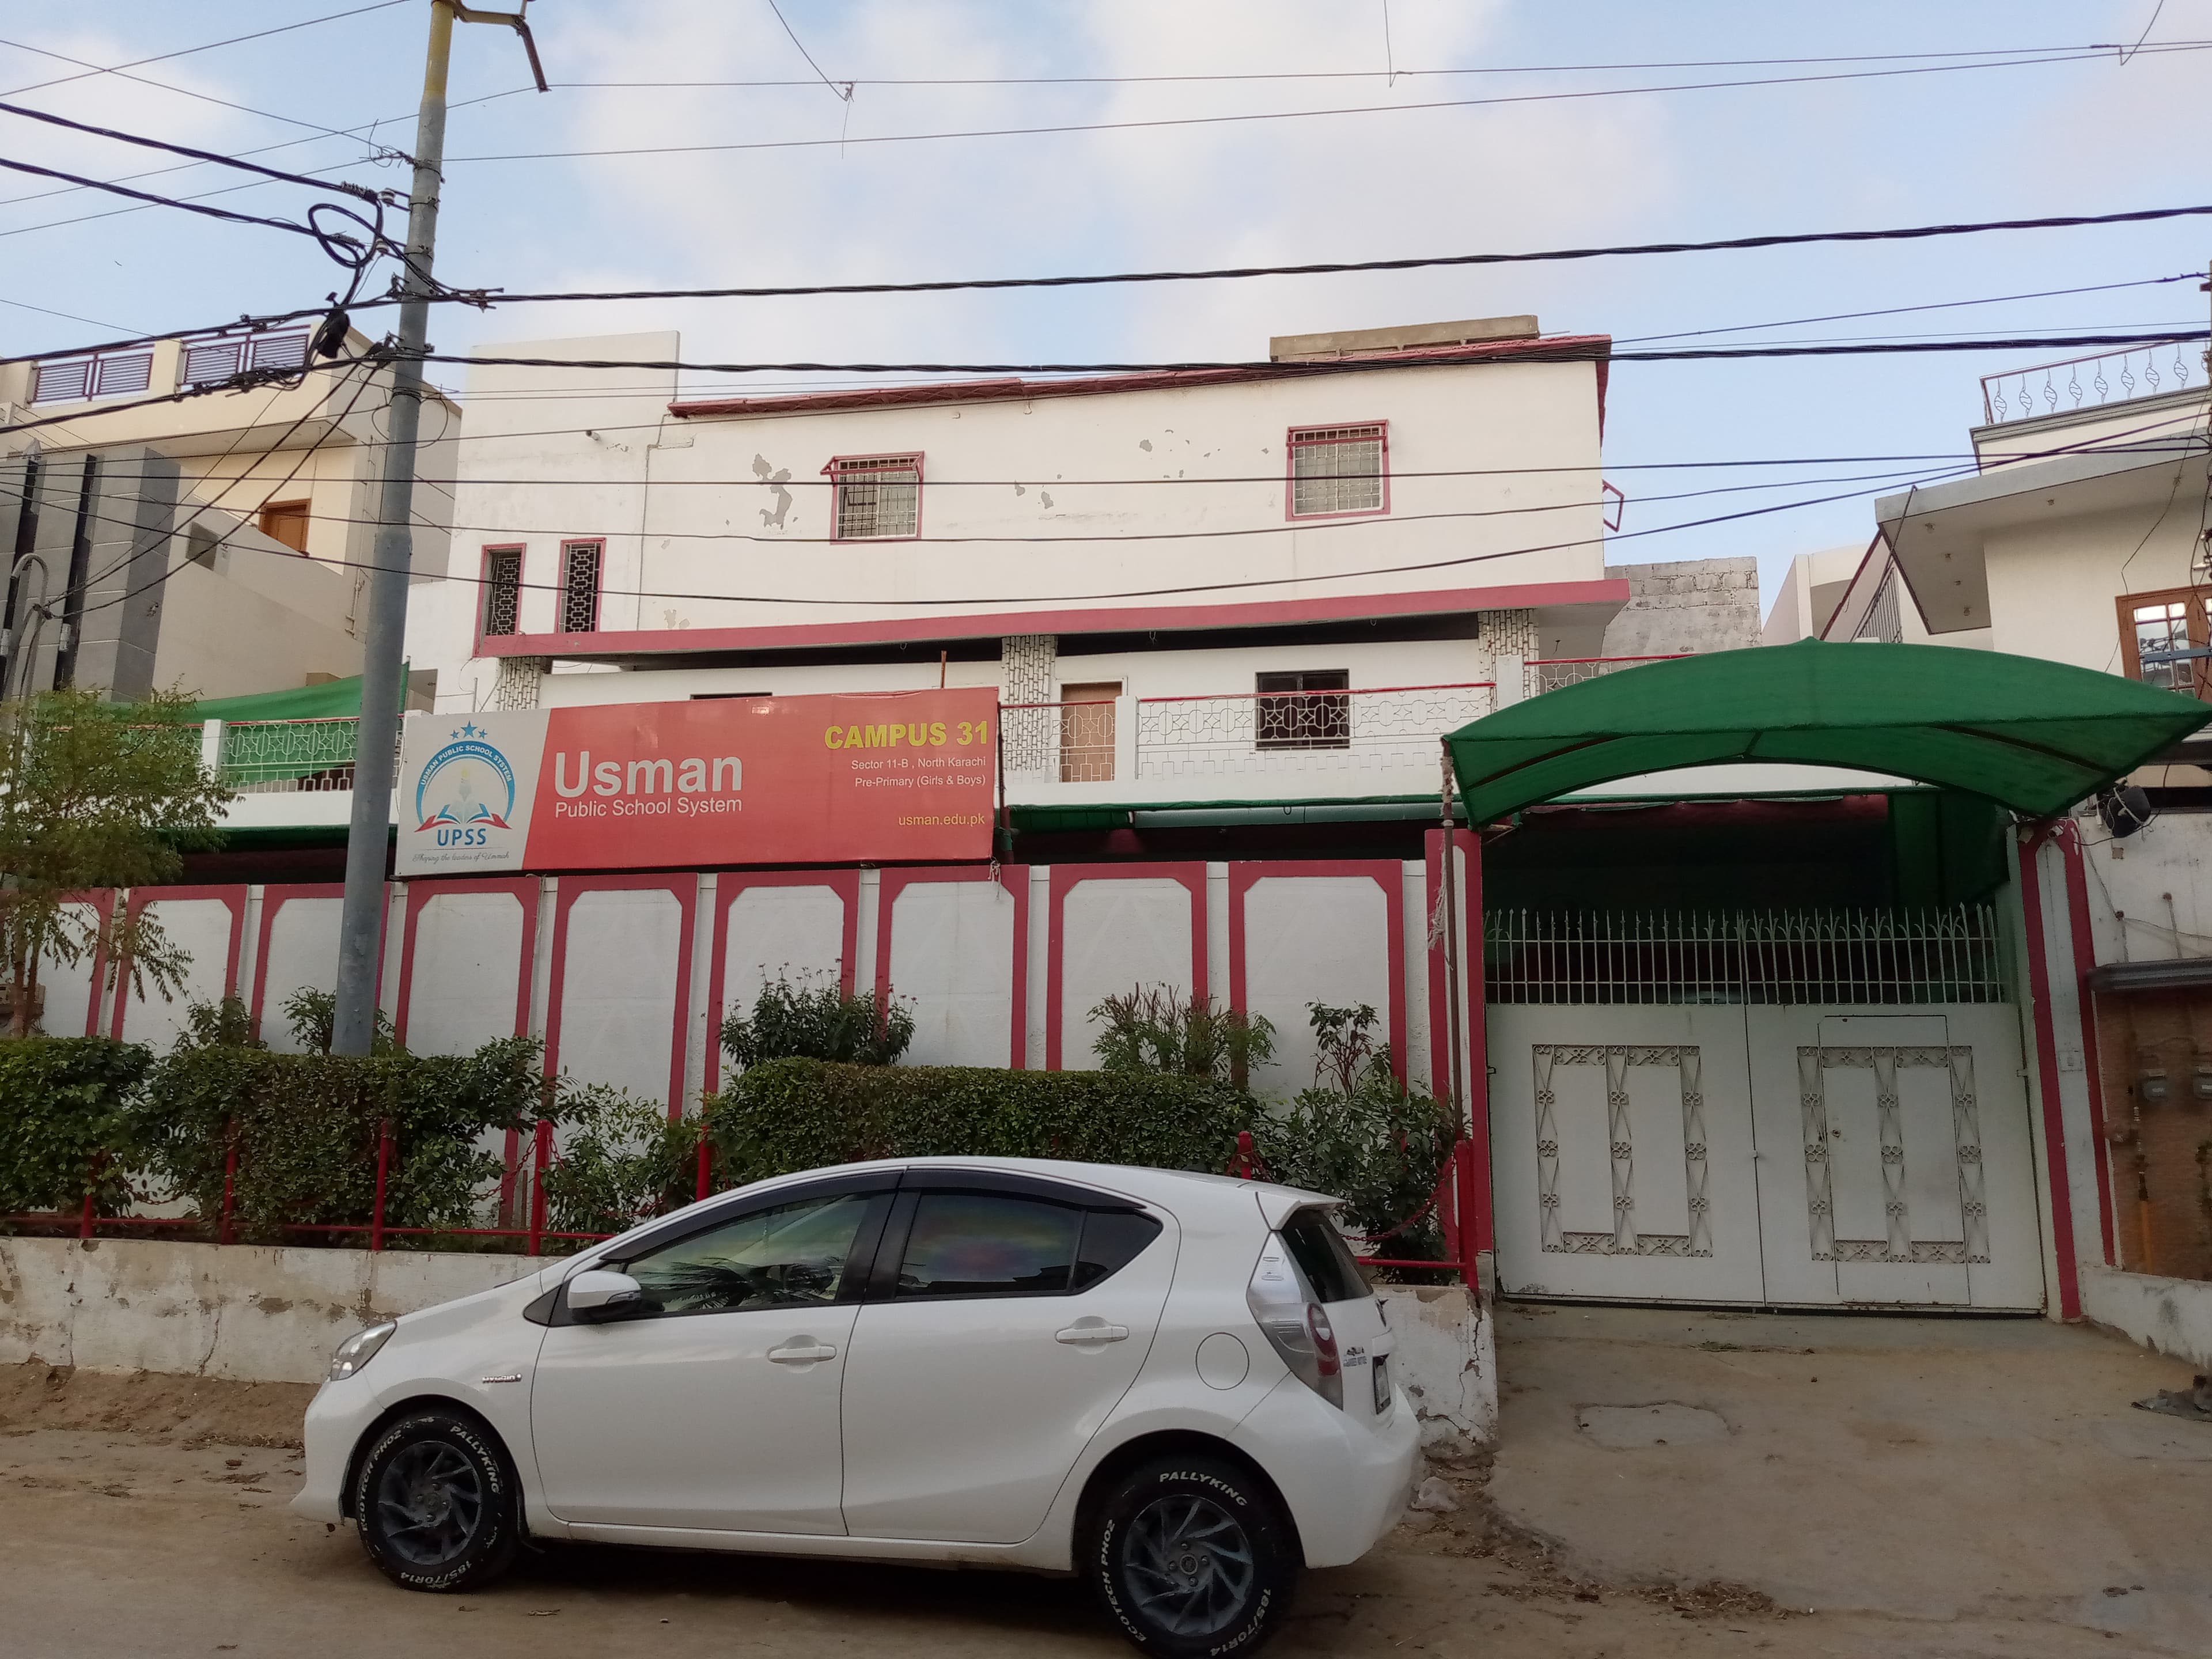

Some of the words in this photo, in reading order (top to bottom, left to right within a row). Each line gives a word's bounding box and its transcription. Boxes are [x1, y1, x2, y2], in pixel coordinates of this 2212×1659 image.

[825, 722, 946, 749] CAMPUS
[956, 721, 987, 745] 31
[421, 760, 438, 785] USMAN
[438, 746, 464, 761] PUBLIC
[465, 745, 493, 757] SCHOOL
[493, 755, 512, 782] SYSTEM
[851, 760, 883, 770] Sector
[887, 759, 908, 768] 11-B
[918, 757, 945, 768] North
[948, 756, 986, 767] Karachi
[555, 751, 742, 798] Usman
[855, 777, 914, 788] Pre-Primary
[916, 775, 943, 787] (Girls
[946, 776, 953, 785] &
[957, 774, 986, 786] Boys)
[555, 801, 607, 818] Public
[612, 797, 671, 816] School
[677, 797, 742, 817] System
[899, 813, 985, 827] usman.edu.pk
[437, 828, 487, 846] UPSS
[1159, 1471, 1247, 1506] PALLYKING
